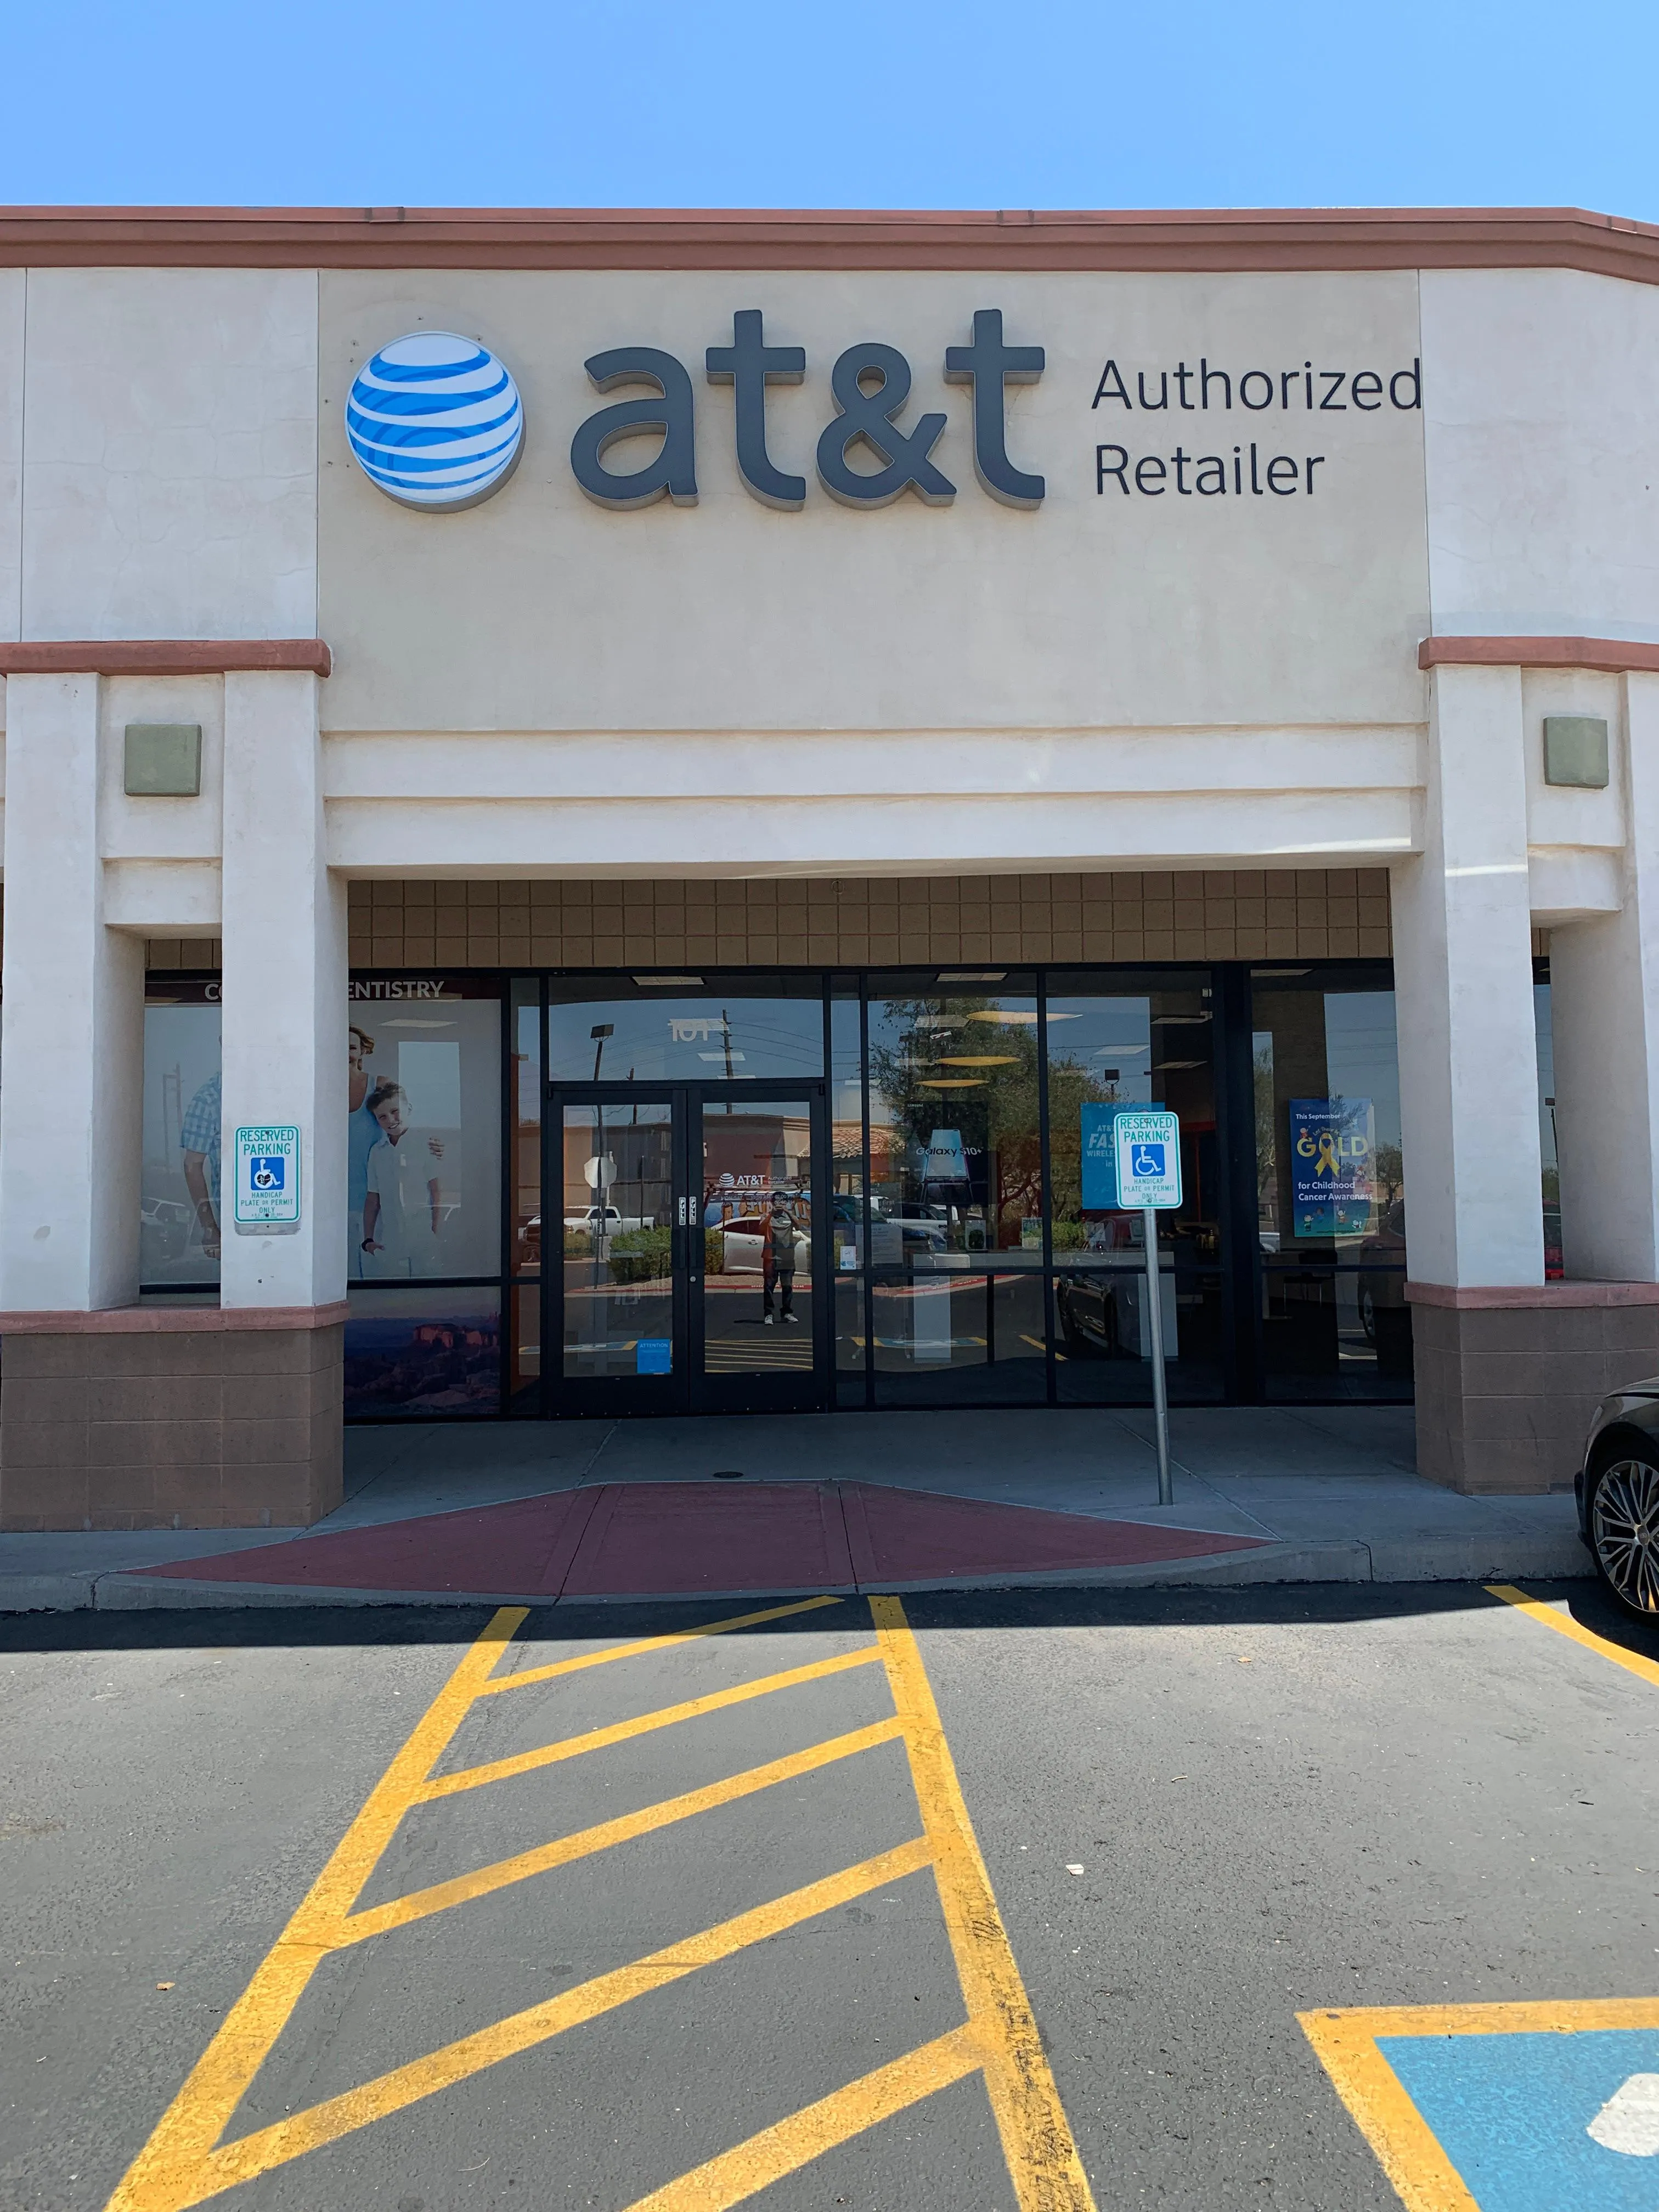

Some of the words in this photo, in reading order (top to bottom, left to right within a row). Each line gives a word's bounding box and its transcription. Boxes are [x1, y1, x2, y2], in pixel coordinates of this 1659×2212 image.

[1092, 358, 1421, 410] Authorized
[571, 309, 1046, 506] at&t
[1096, 443, 1325, 495] Retailer
[348, 981, 444, 998] ENTISTRY
[1120, 1117, 1172, 1129] RESERVED
[240, 1130, 294, 1142] RESERVED
[1124, 1130, 1170, 1142] PARKING
[244, 1143, 291, 1155] PARKING
[916, 1147, 957, 1157] Galaxy
[960, 1147, 982, 1155] S10+
[736, 1175, 765, 1186] AT&T
[1312, 1181, 1355, 1189] Childhood
